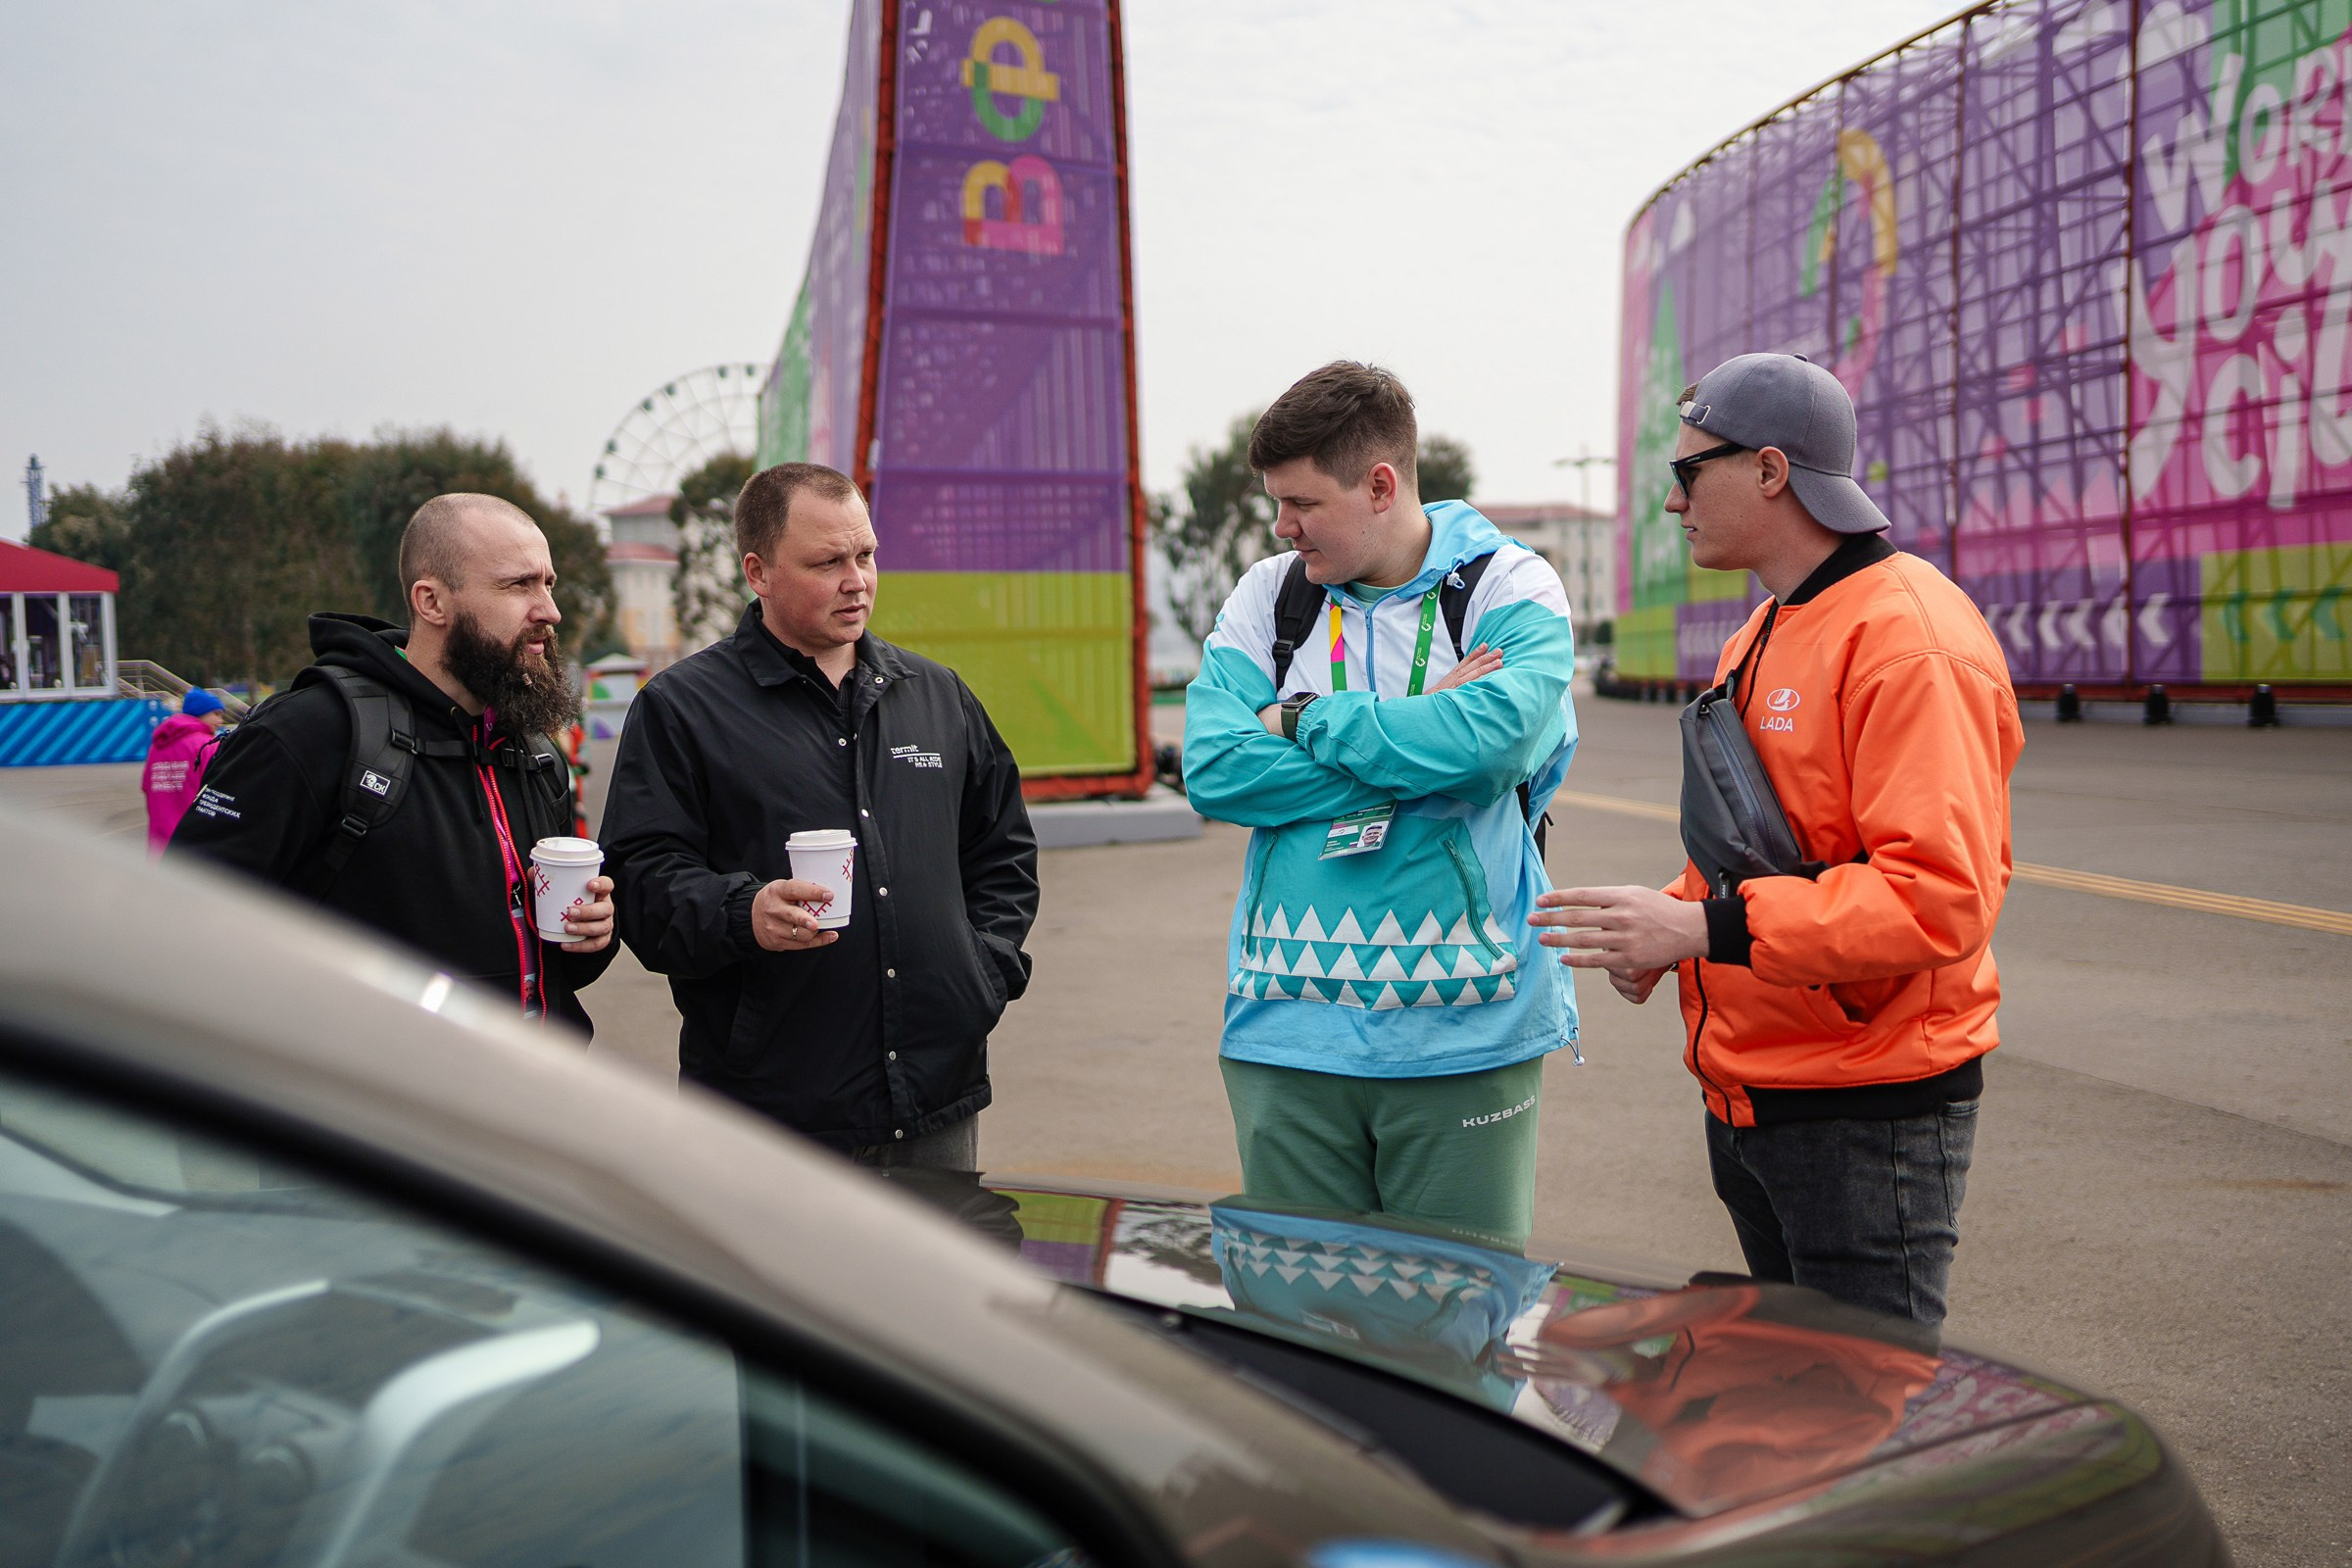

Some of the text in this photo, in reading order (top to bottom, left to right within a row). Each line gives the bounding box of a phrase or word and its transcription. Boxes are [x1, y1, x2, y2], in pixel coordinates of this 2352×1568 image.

[959, 0, 1065, 256] ВФ
[2142, 43, 2352, 232] WOR
[1759, 715, 1793, 732] LADA
[890, 744, 919, 755] termit
[1462, 1095, 1537, 1128] KUZBASS
